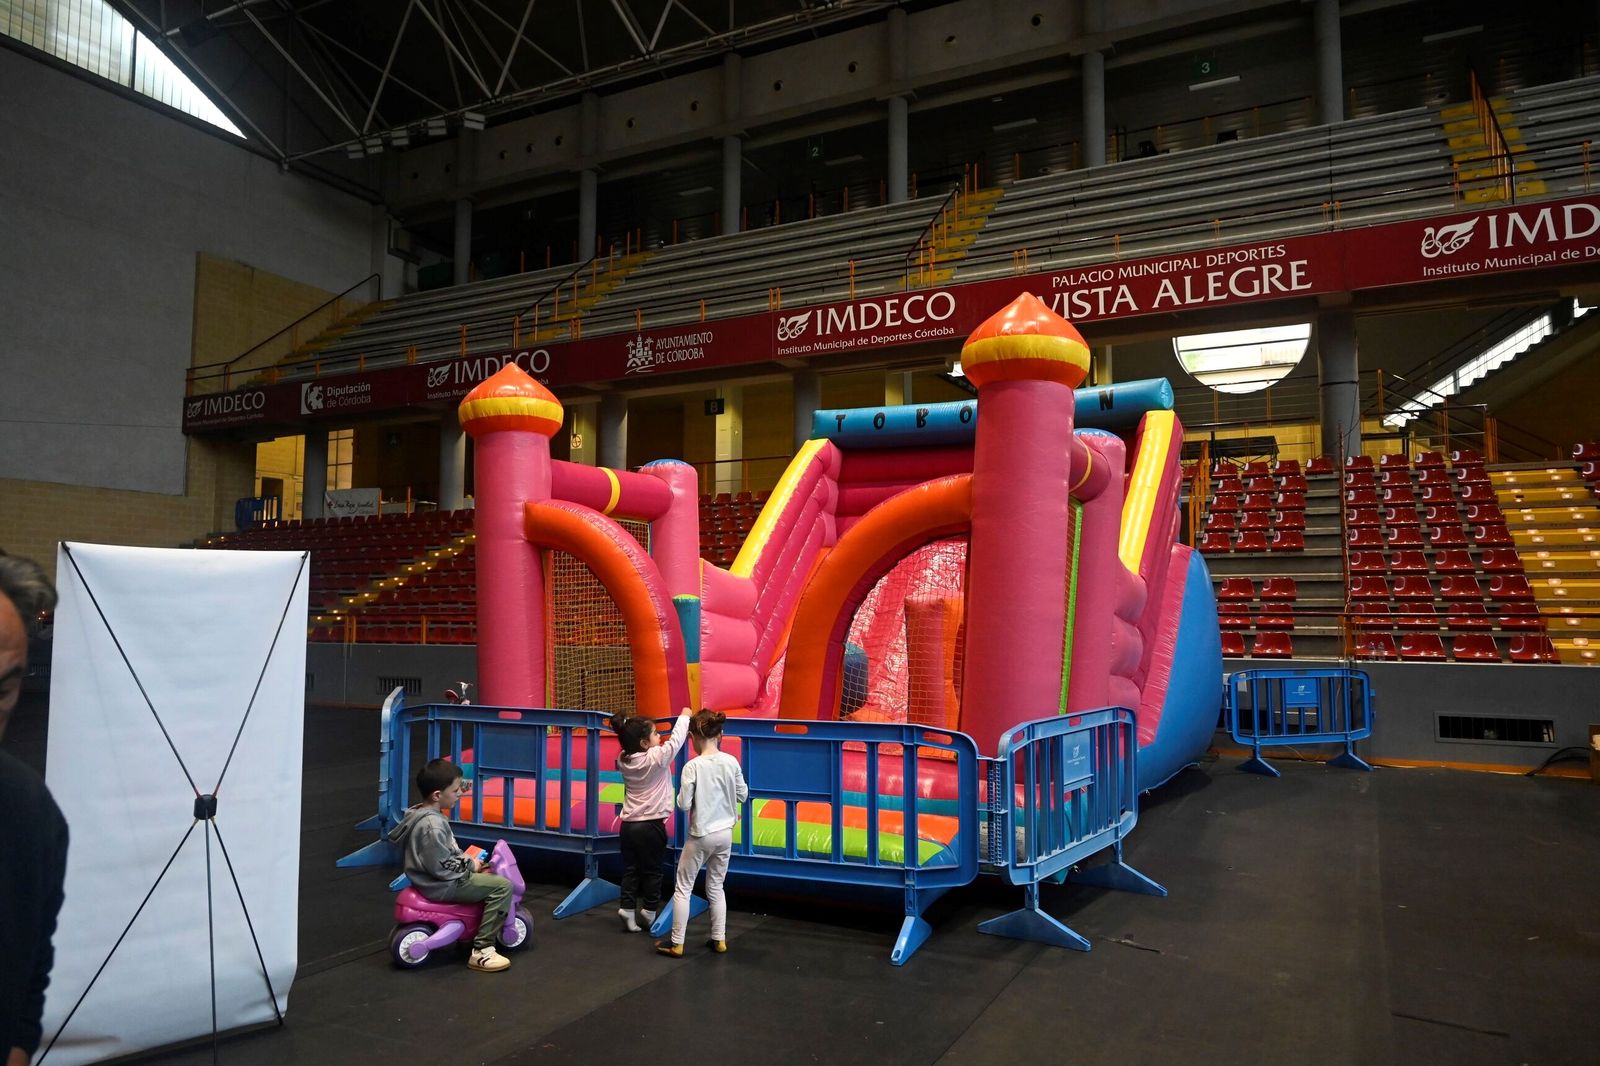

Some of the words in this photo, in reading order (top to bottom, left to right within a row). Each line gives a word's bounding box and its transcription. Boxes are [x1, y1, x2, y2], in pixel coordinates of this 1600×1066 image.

[1200, 61, 1211, 74] 3
[811, 146, 820, 157] 2
[1052, 268, 1114, 288] PALACIO
[1117, 257, 1201, 280] MUNICIPAL
[1205, 244, 1286, 268] DEPORTES
[1423, 261, 1480, 277] Instituto
[1484, 250, 1557, 270] Municipal
[1560, 248, 1580, 260] de
[1151, 259, 1313, 309] ALEGRE
[816, 291, 957, 336] IMDECO
[655, 331, 714, 350] AYUNTAMIENTO
[777, 344, 812, 356] Instituto
[813, 338, 857, 352] Municipal
[857, 336, 869, 347] de
[871, 332, 913, 346] Deportes
[914, 326, 955, 340] Córdoba
[655, 351, 666, 364] DE
[327, 382, 371, 399] Diputación
[204, 391, 266, 416] IMDECO
